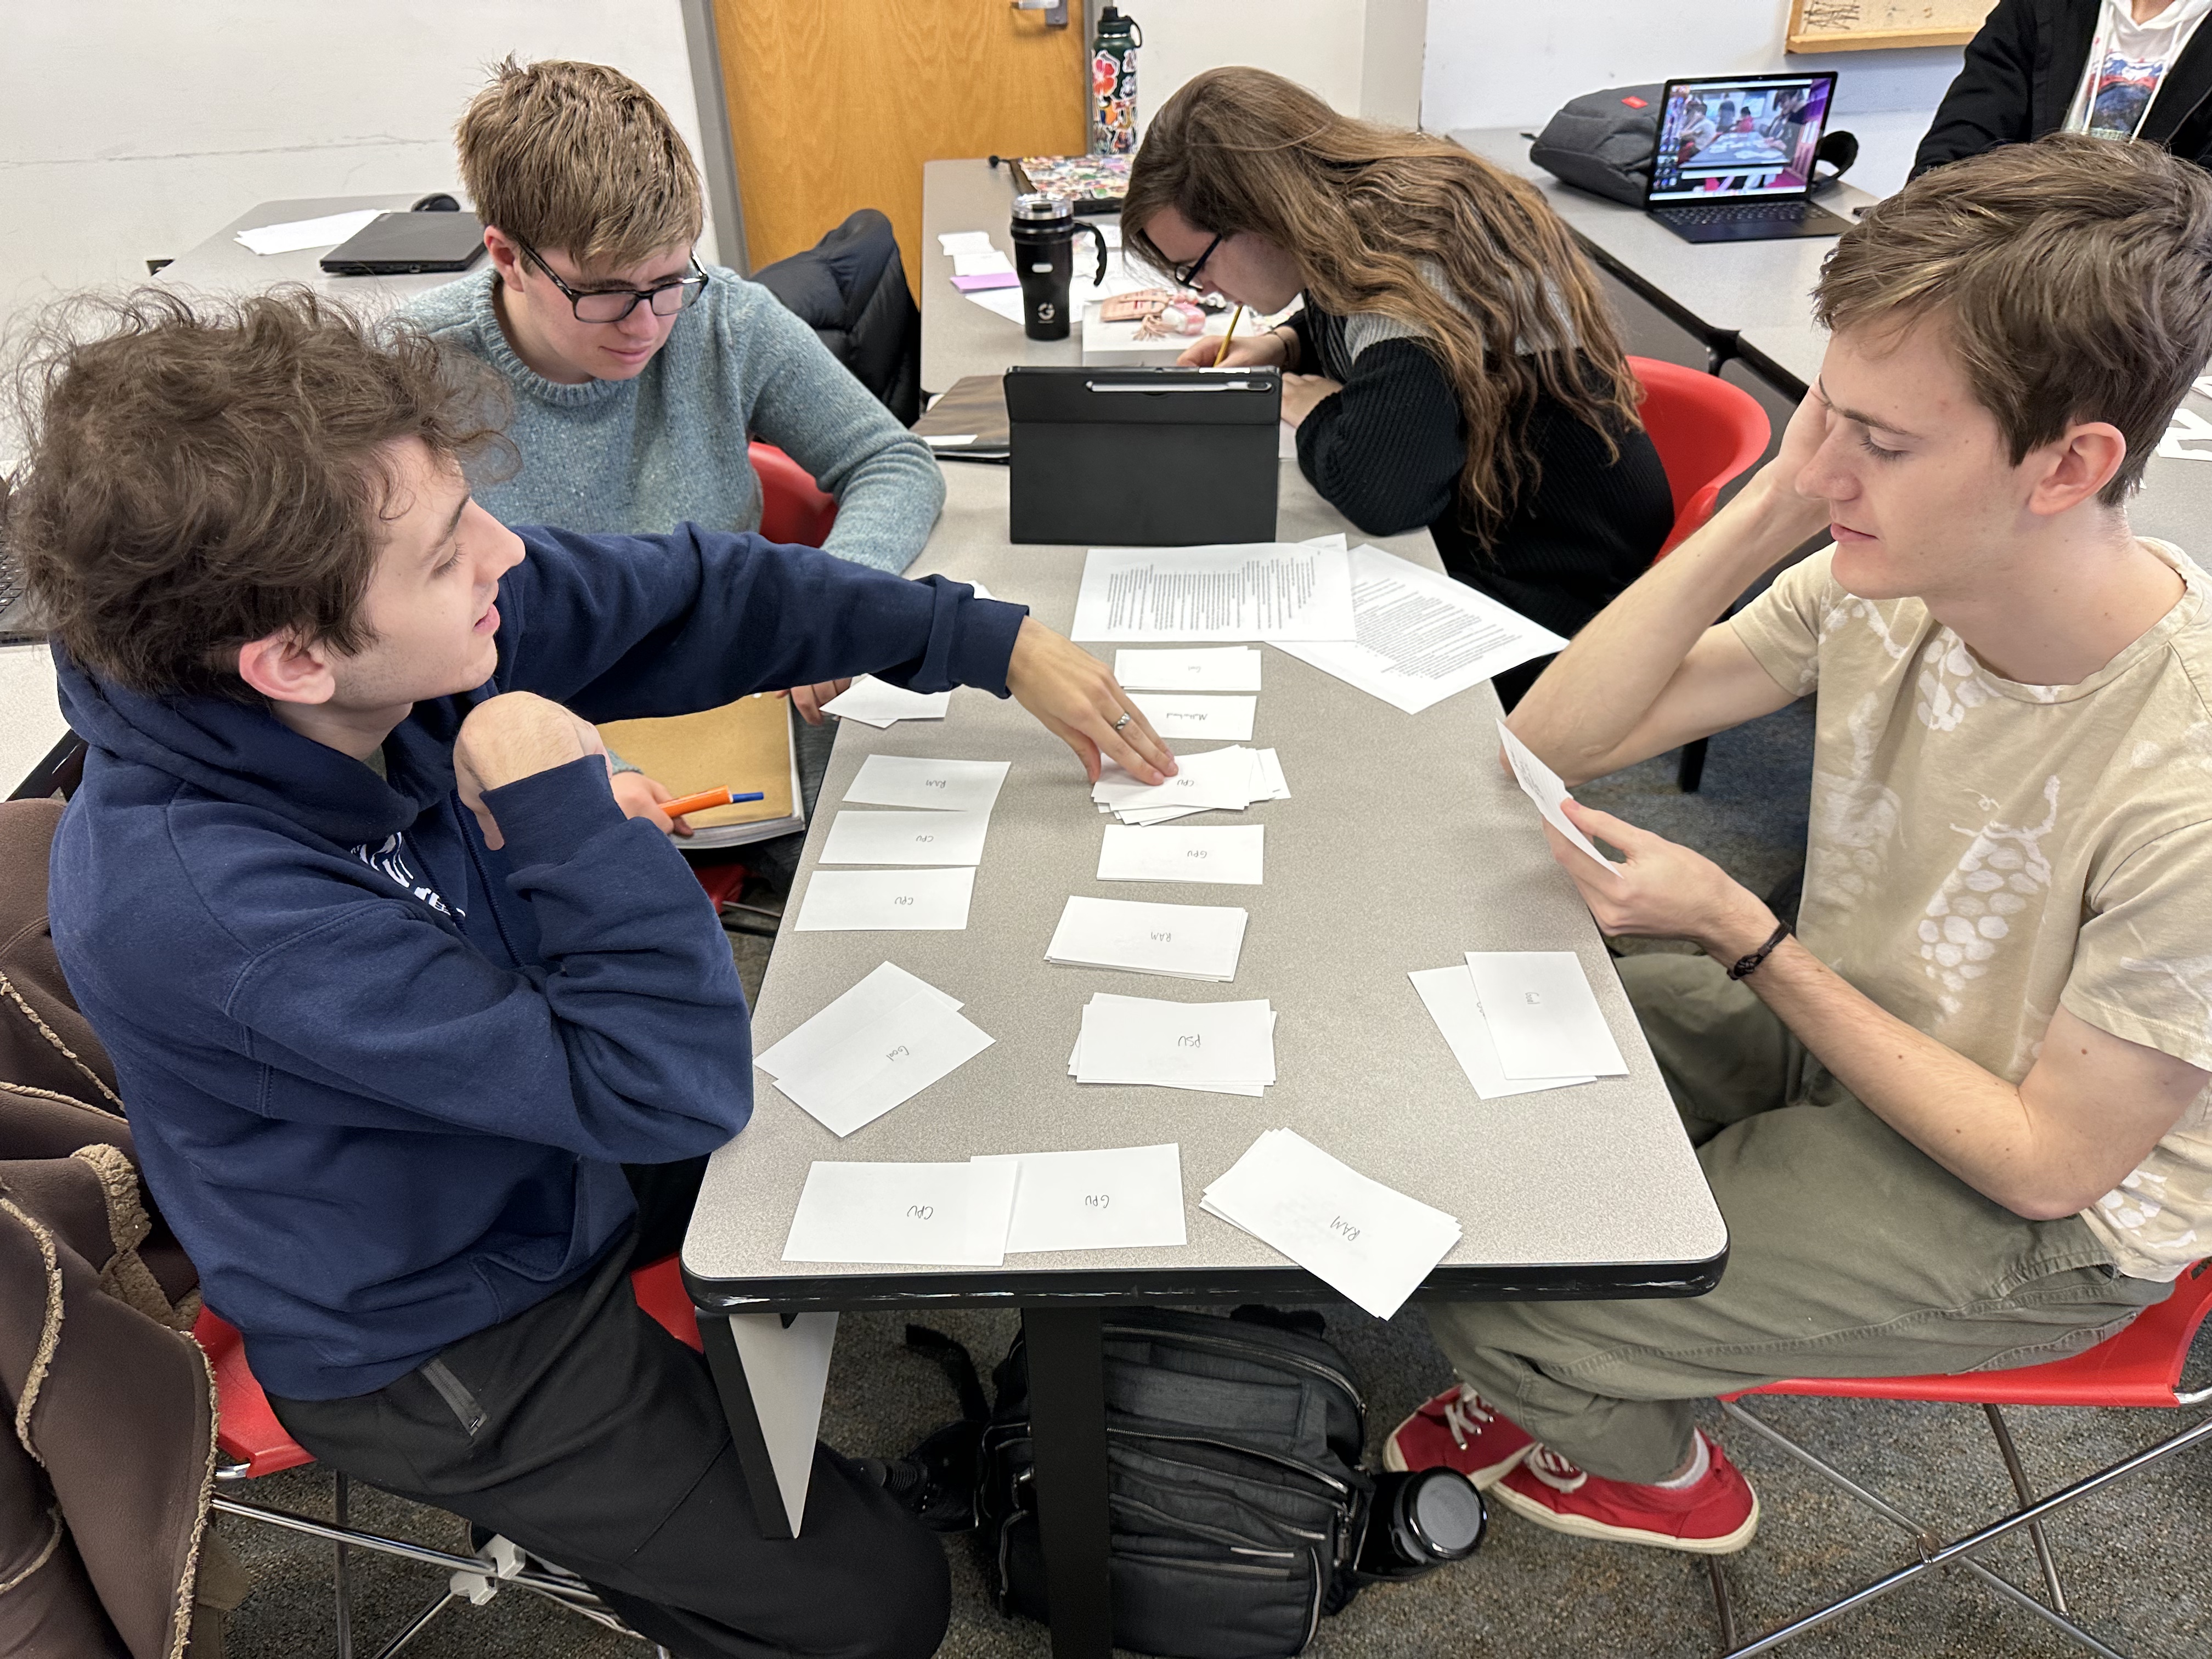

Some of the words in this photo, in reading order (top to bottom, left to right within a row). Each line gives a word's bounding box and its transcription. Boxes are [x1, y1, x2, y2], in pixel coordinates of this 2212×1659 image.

[926, 780, 946, 789] RAM
[1187, 850, 1207, 859] GPU
[1150, 932, 1171, 943] RAM
[1178, 1034, 1201, 1048] PSU
[885, 1045, 910, 1062] Goal
[1085, 1194, 1109, 1209] GPU
[906, 1205, 934, 1220] CPU
[1330, 1215, 1361, 1242] RAM
